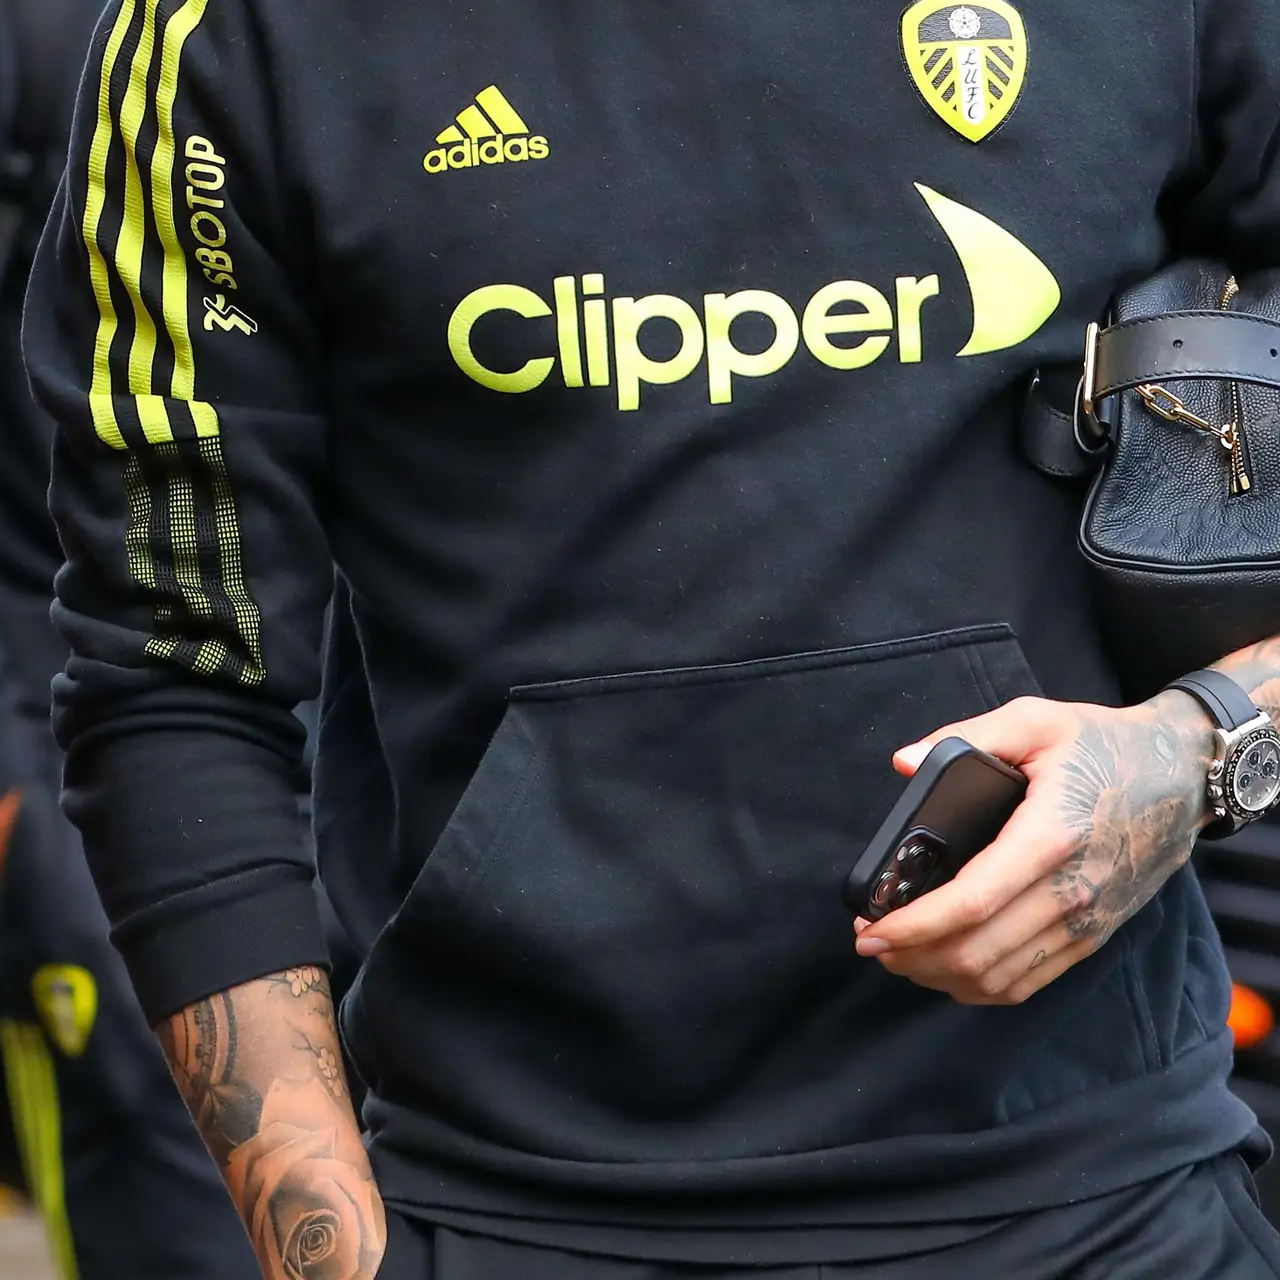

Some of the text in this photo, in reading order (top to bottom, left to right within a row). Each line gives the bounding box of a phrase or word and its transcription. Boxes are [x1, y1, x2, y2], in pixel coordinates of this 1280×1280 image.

[961, 48, 981, 120] LUFC
[423, 133, 550, 174] adidas
[184, 134, 238, 291] SBOTOP
[447, 273, 940, 411] Clipper
